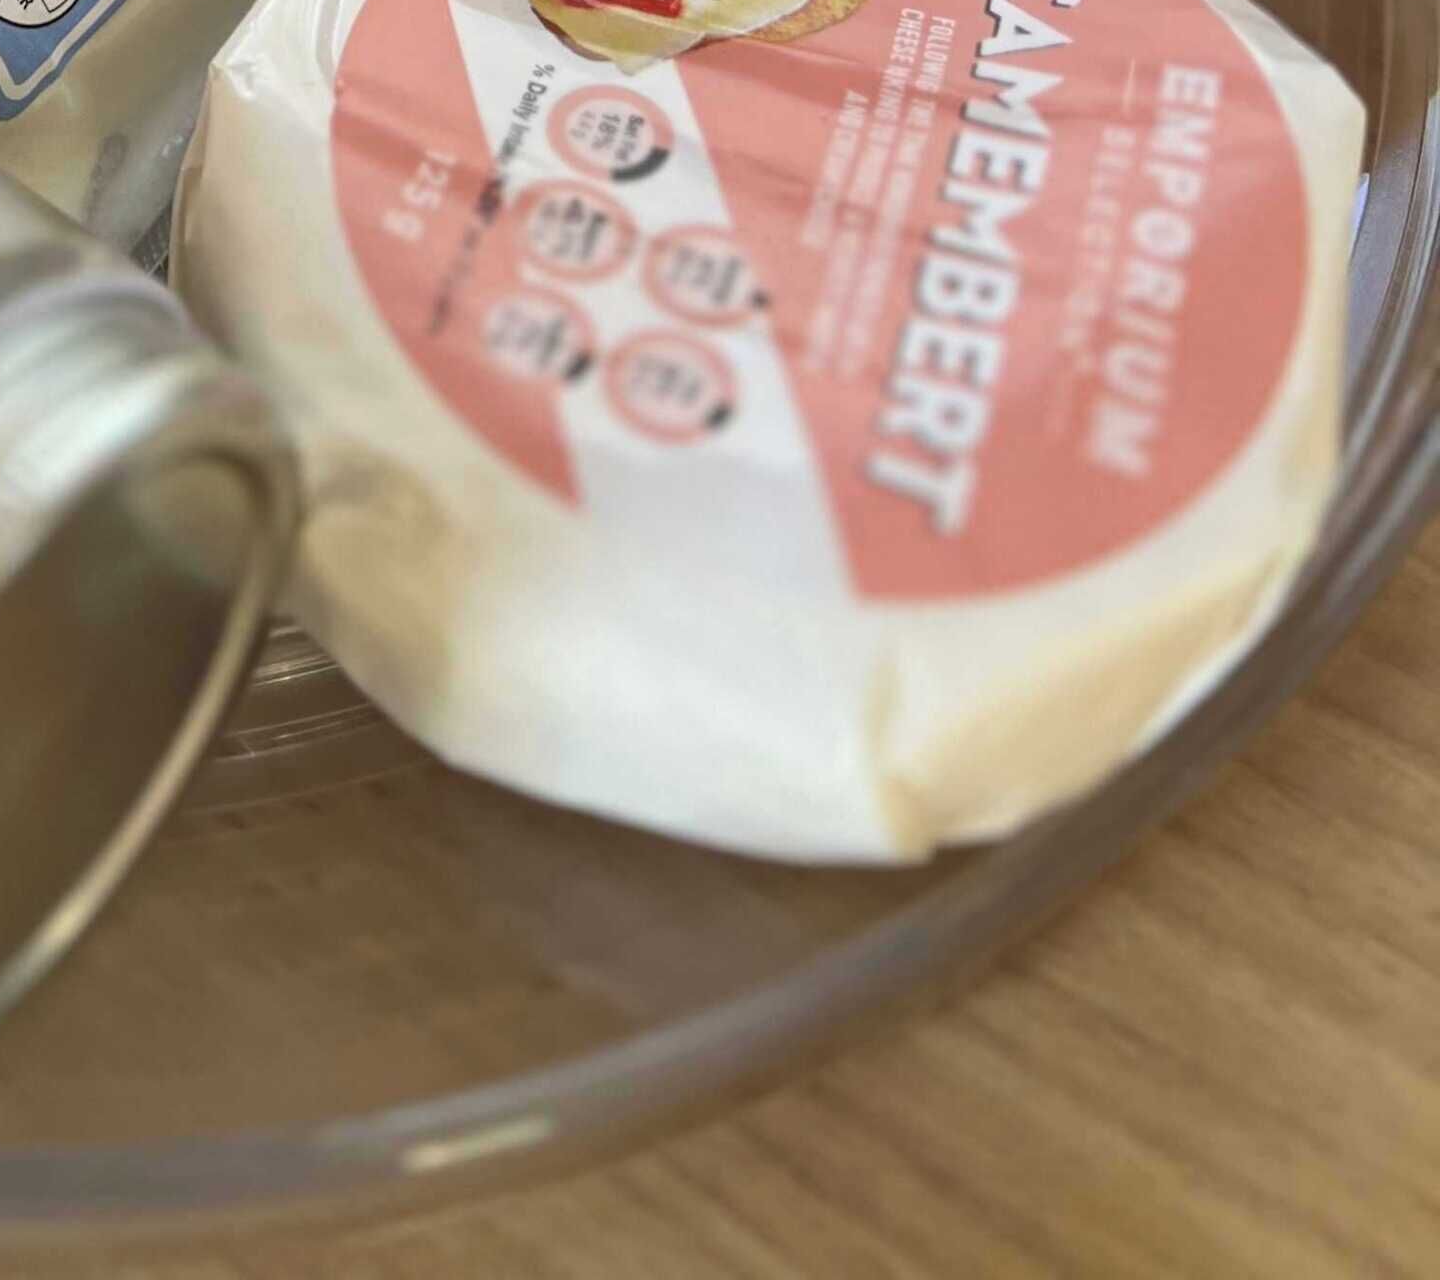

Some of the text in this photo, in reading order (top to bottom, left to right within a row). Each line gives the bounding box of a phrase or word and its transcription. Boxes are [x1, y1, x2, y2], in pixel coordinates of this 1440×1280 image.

[887, 5, 926, 65] CHEESE
[512, 79, 548, 121] Daily
[1086, 64, 1221, 480] EMPORIUM
